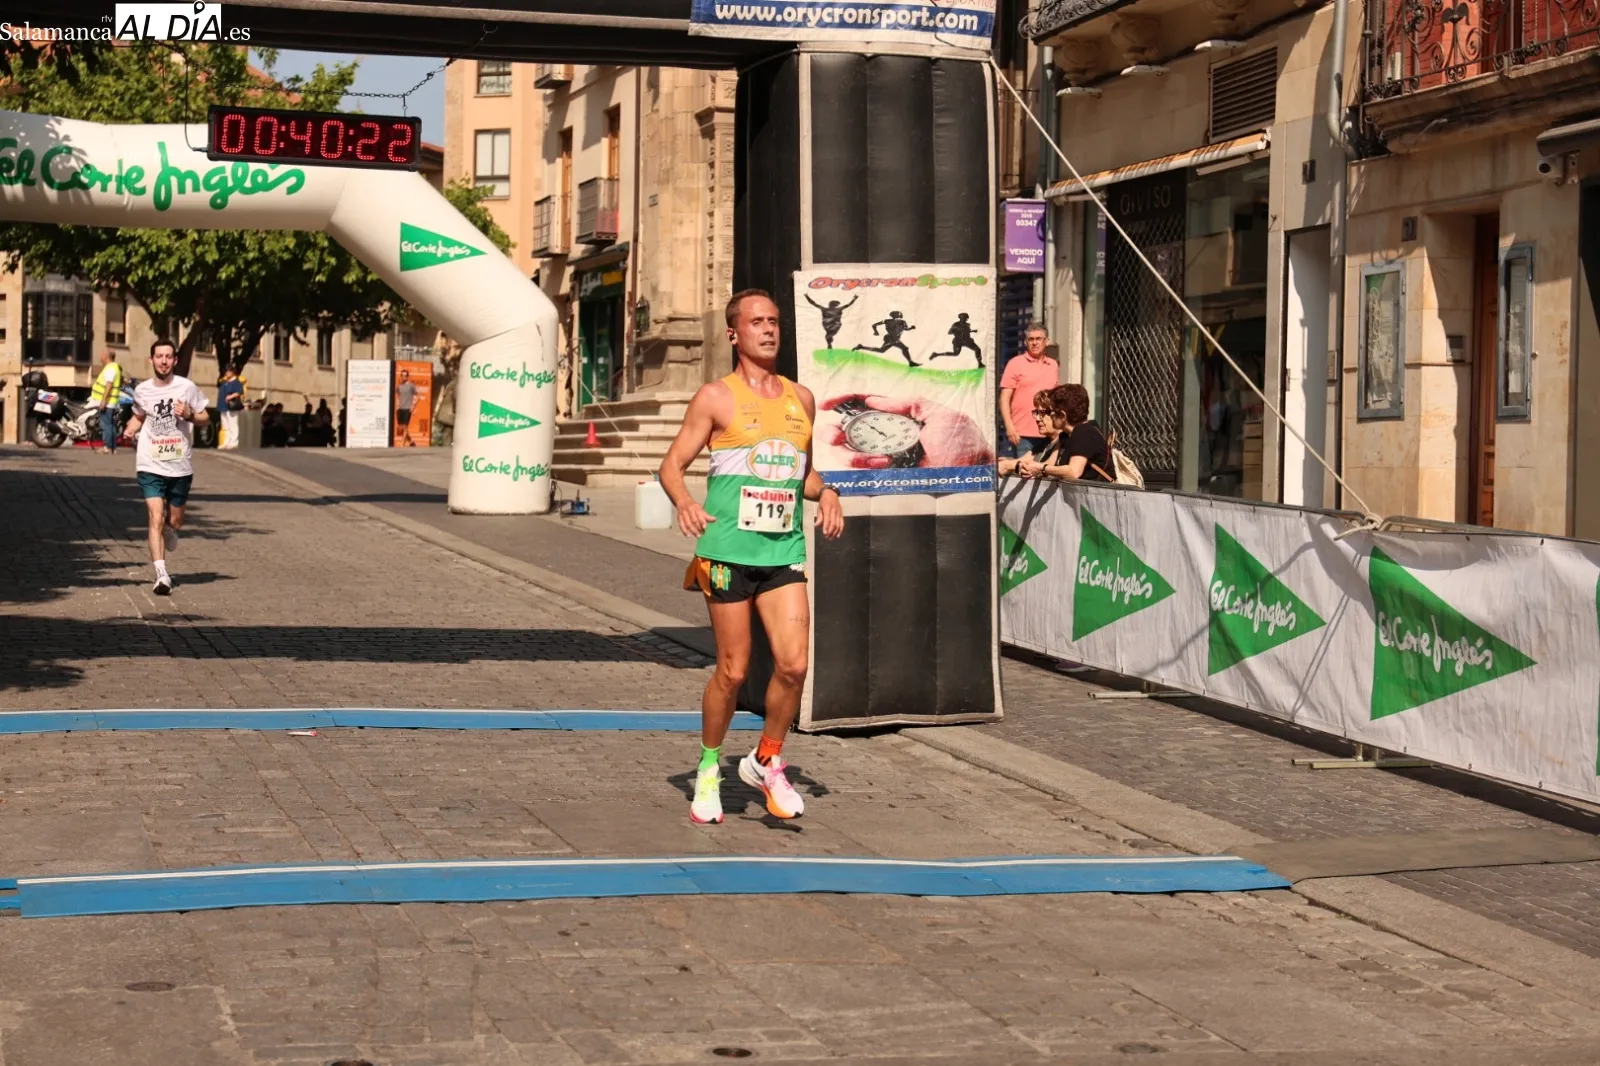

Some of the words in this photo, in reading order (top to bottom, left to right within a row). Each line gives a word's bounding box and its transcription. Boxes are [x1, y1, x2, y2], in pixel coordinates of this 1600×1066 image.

[715, 4, 979, 31] www.orycronsport.com
[221, 114, 412, 162] 00:40:22
[0, 137, 37, 186] El
[41, 145, 147, 196] Corte
[153, 141, 306, 211] Inglés
[401, 241, 413, 253] El
[412, 241, 437, 254] Corte
[436, 240, 471, 258] Inglés
[1009, 248, 1043, 256] VENDIDO
[1017, 256, 1035, 265] AQUÍ
[470, 362, 481, 379] El
[482, 363, 517, 381] Corte
[488, 414, 506, 426] Corte
[158, 444, 176, 454] 246
[463, 455, 474, 472] El
[475, 457, 510, 475] Corte
[753, 454, 796, 469] ALCER
[824, 475, 992, 488] ww.orycronsport.com
[756, 503, 785, 518] 119
[1078, 556, 1089, 585] El
[1089, 560, 1113, 591] Corte
[1112, 557, 1153, 604] Inglés
[1211, 580, 1226, 612] El
[1224, 585, 1254, 619] Corte
[1253, 582, 1296, 636] Inglés
[1379, 611, 1394, 647] El
[1393, 616, 1431, 657] Corte
[1433, 615, 1493, 676] Inglés
